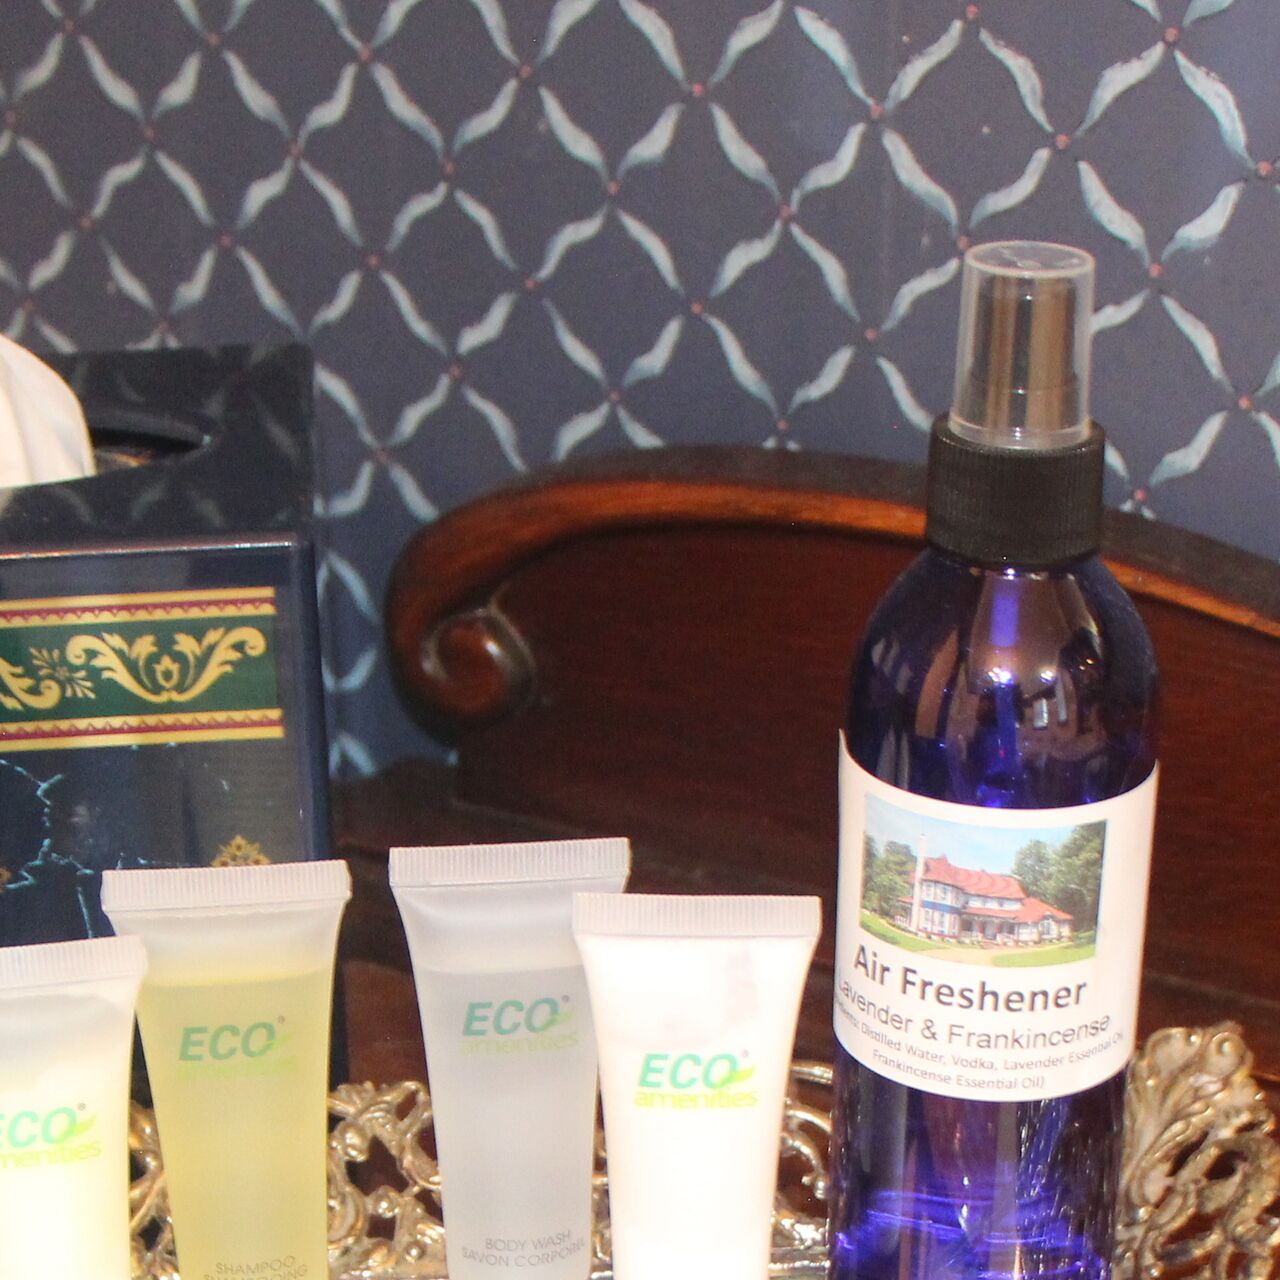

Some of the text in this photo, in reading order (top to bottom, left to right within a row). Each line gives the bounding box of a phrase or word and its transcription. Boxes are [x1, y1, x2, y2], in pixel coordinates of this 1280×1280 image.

[854, 944, 890, 985] Air
[902, 966, 1087, 1012] Freshener
[462, 997, 559, 1037] ECO
[838, 968, 913, 1032] Lavender
[921, 1018, 938, 1041] &
[948, 1014, 1111, 1050] Frankincense
[179, 1022, 276, 1061] ECO
[639, 1053, 738, 1089] ECO
[872, 1048, 952, 1084] Frankincense
[952, 1053, 998, 1072] Vodka,
[1003, 1055, 1064, 1071] Lavender
[485, 1229, 571, 1252] BODY WASH
[215, 1255, 296, 1276] SHAMPOO
